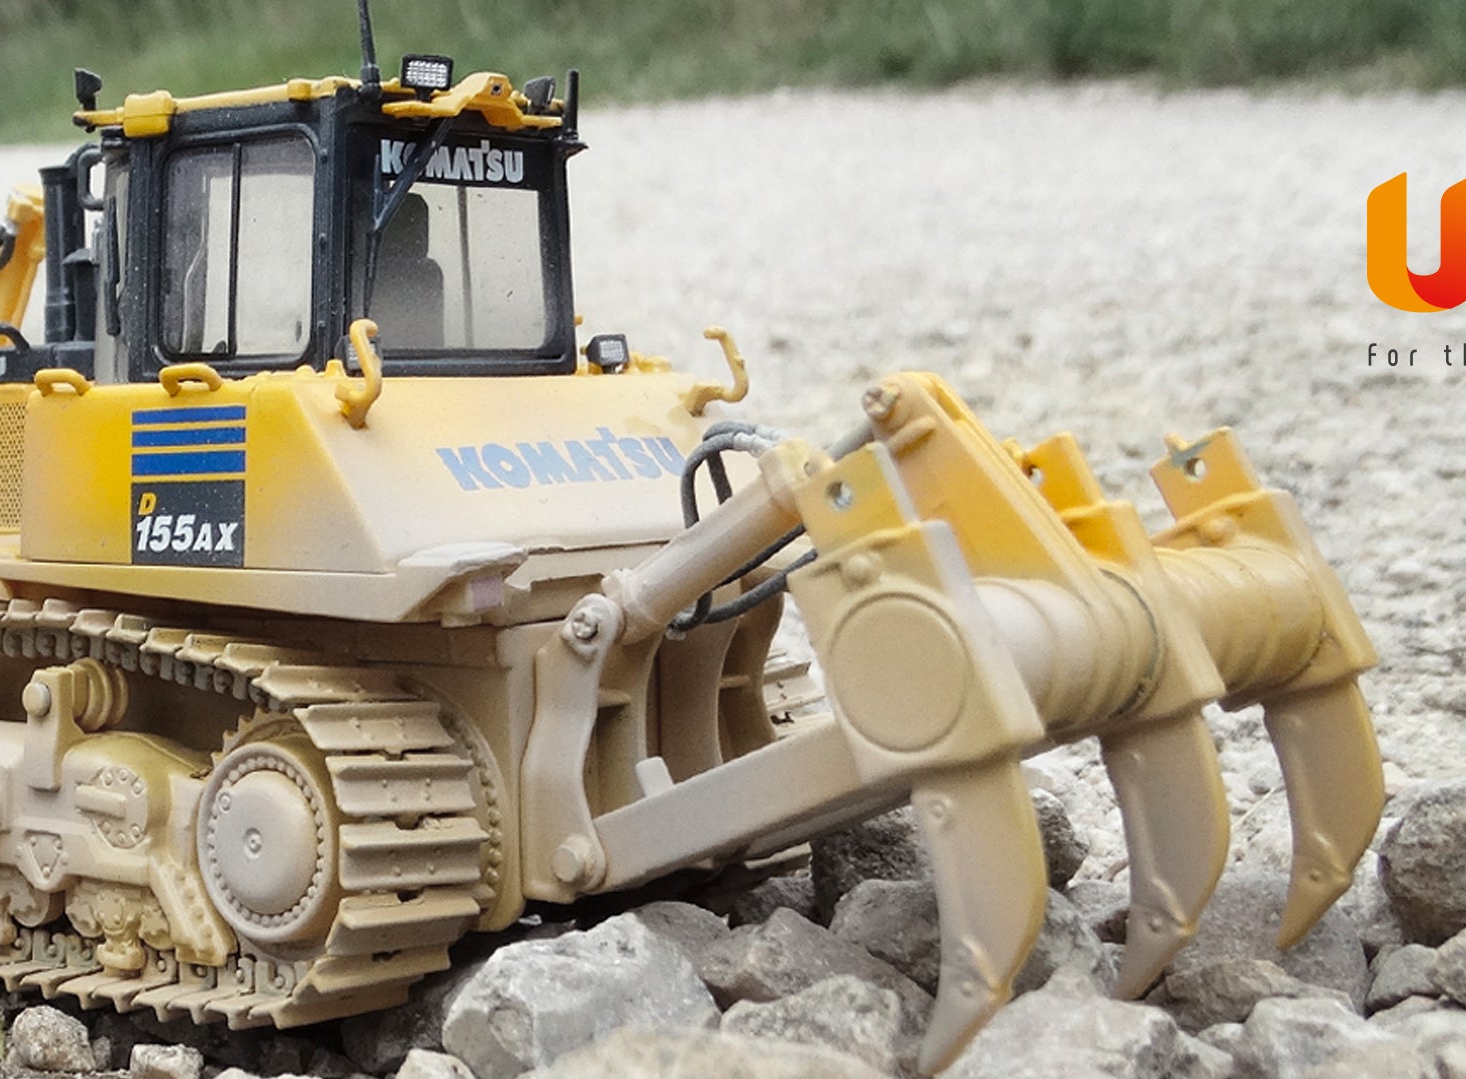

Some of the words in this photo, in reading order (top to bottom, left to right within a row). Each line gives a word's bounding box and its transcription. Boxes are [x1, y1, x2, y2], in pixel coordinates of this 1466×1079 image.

[435, 426, 687, 492] KOMATSU
[138, 492, 157, 516] D
[136, 514, 239, 553] 155AX
